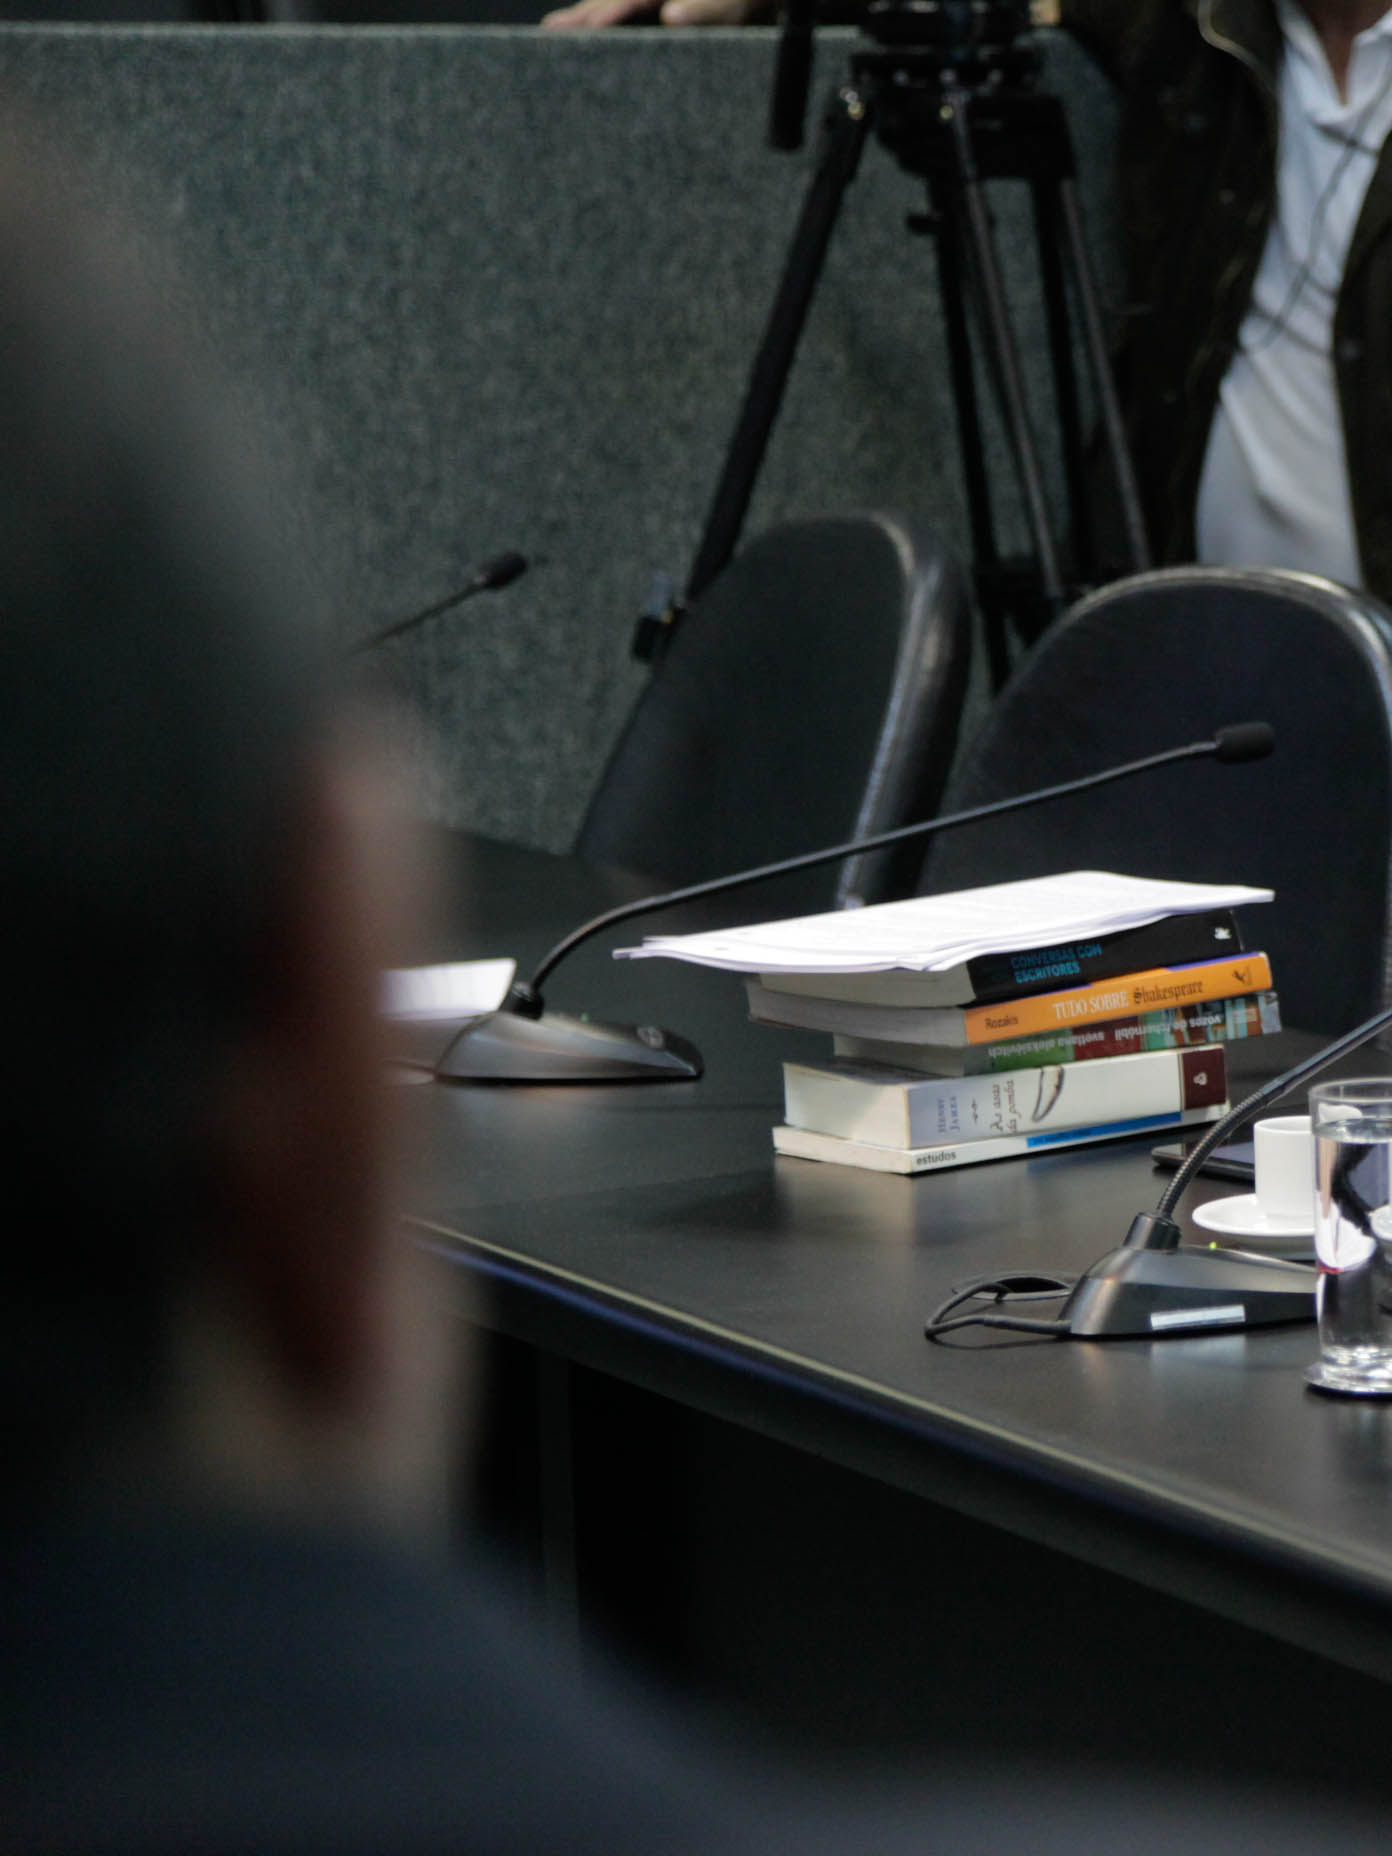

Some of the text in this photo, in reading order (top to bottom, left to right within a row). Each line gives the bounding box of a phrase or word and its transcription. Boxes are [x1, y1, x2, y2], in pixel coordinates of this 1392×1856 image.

[1077, 943, 1103, 958] COM
[1015, 961, 1080, 983] ESCRITORES
[1052, 981, 1203, 1020] TUDO SOBRE Shakespeare
[916, 1151, 956, 1166] estudos
